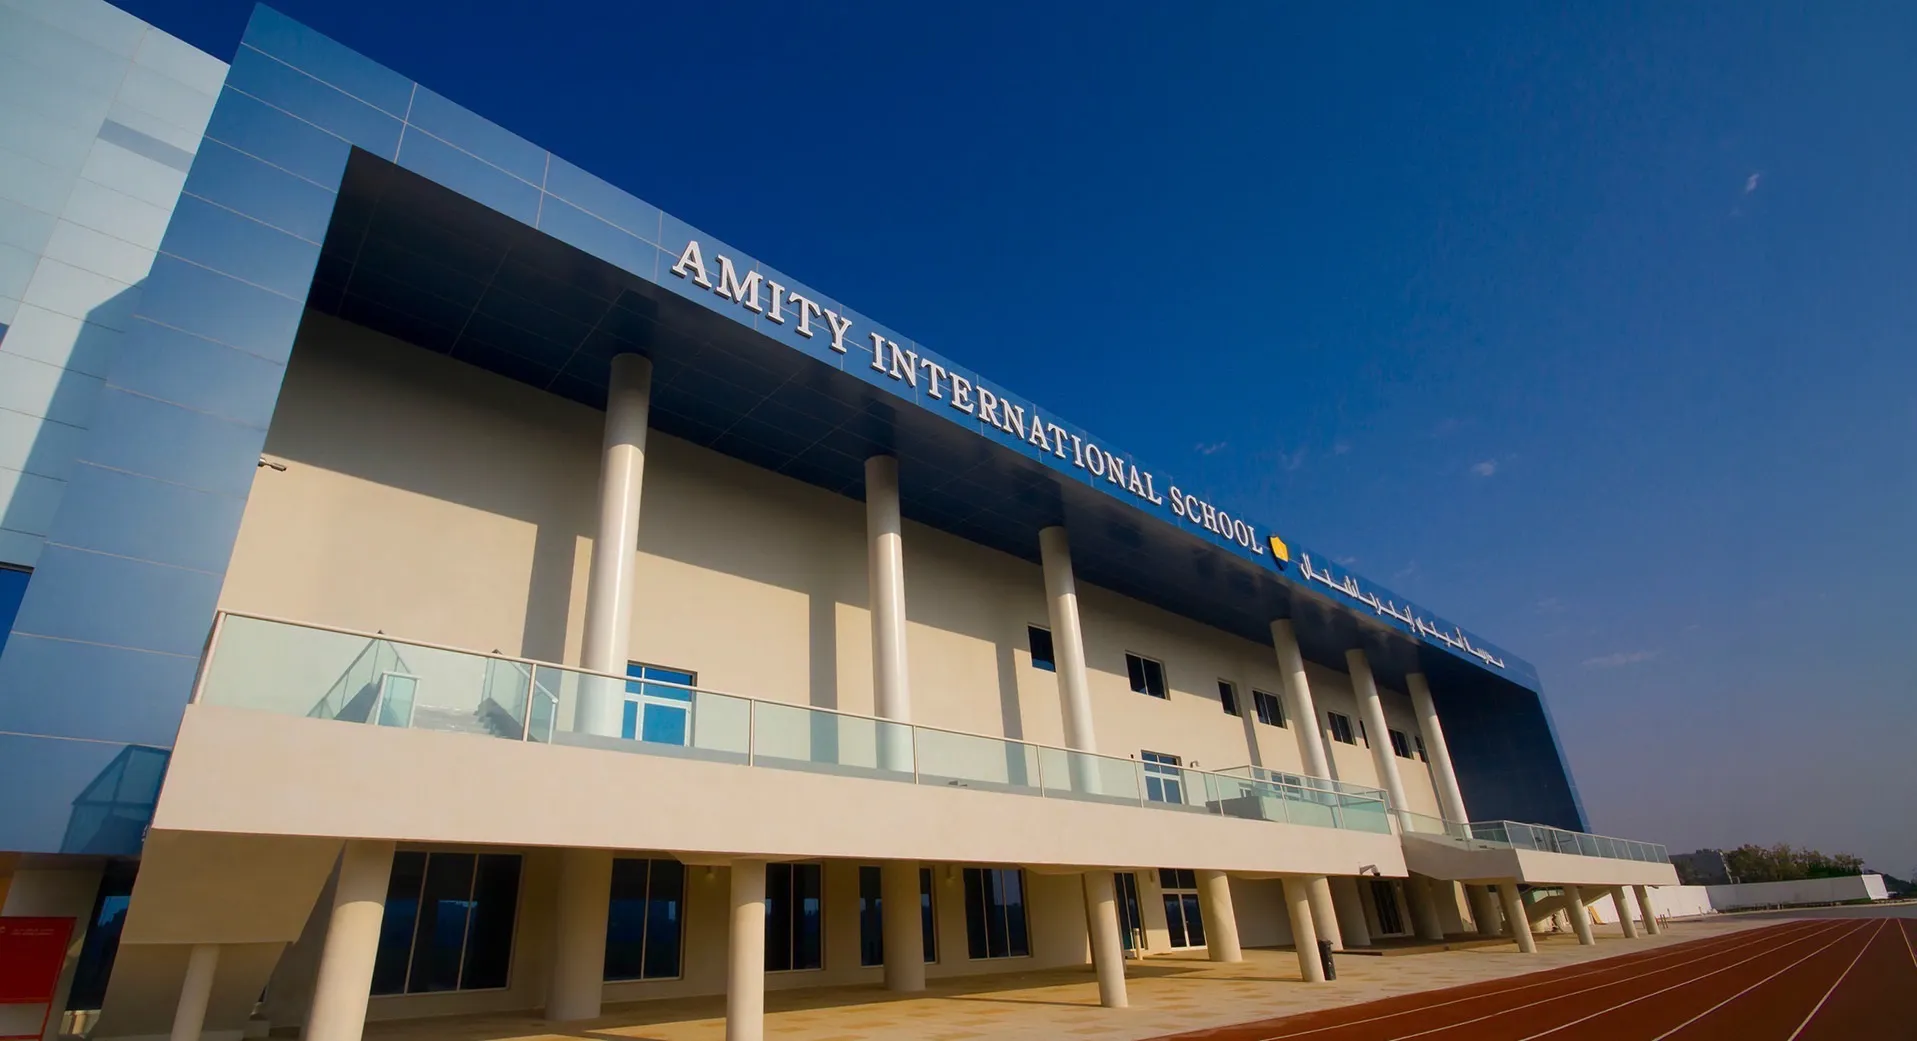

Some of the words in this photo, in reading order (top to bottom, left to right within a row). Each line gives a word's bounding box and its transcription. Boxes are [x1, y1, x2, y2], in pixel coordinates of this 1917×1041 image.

[670, 240, 853, 354] AMITY
[869, 332, 1162, 506] INTERNATIONAL
[1168, 486, 1264, 555] SCHOOL
